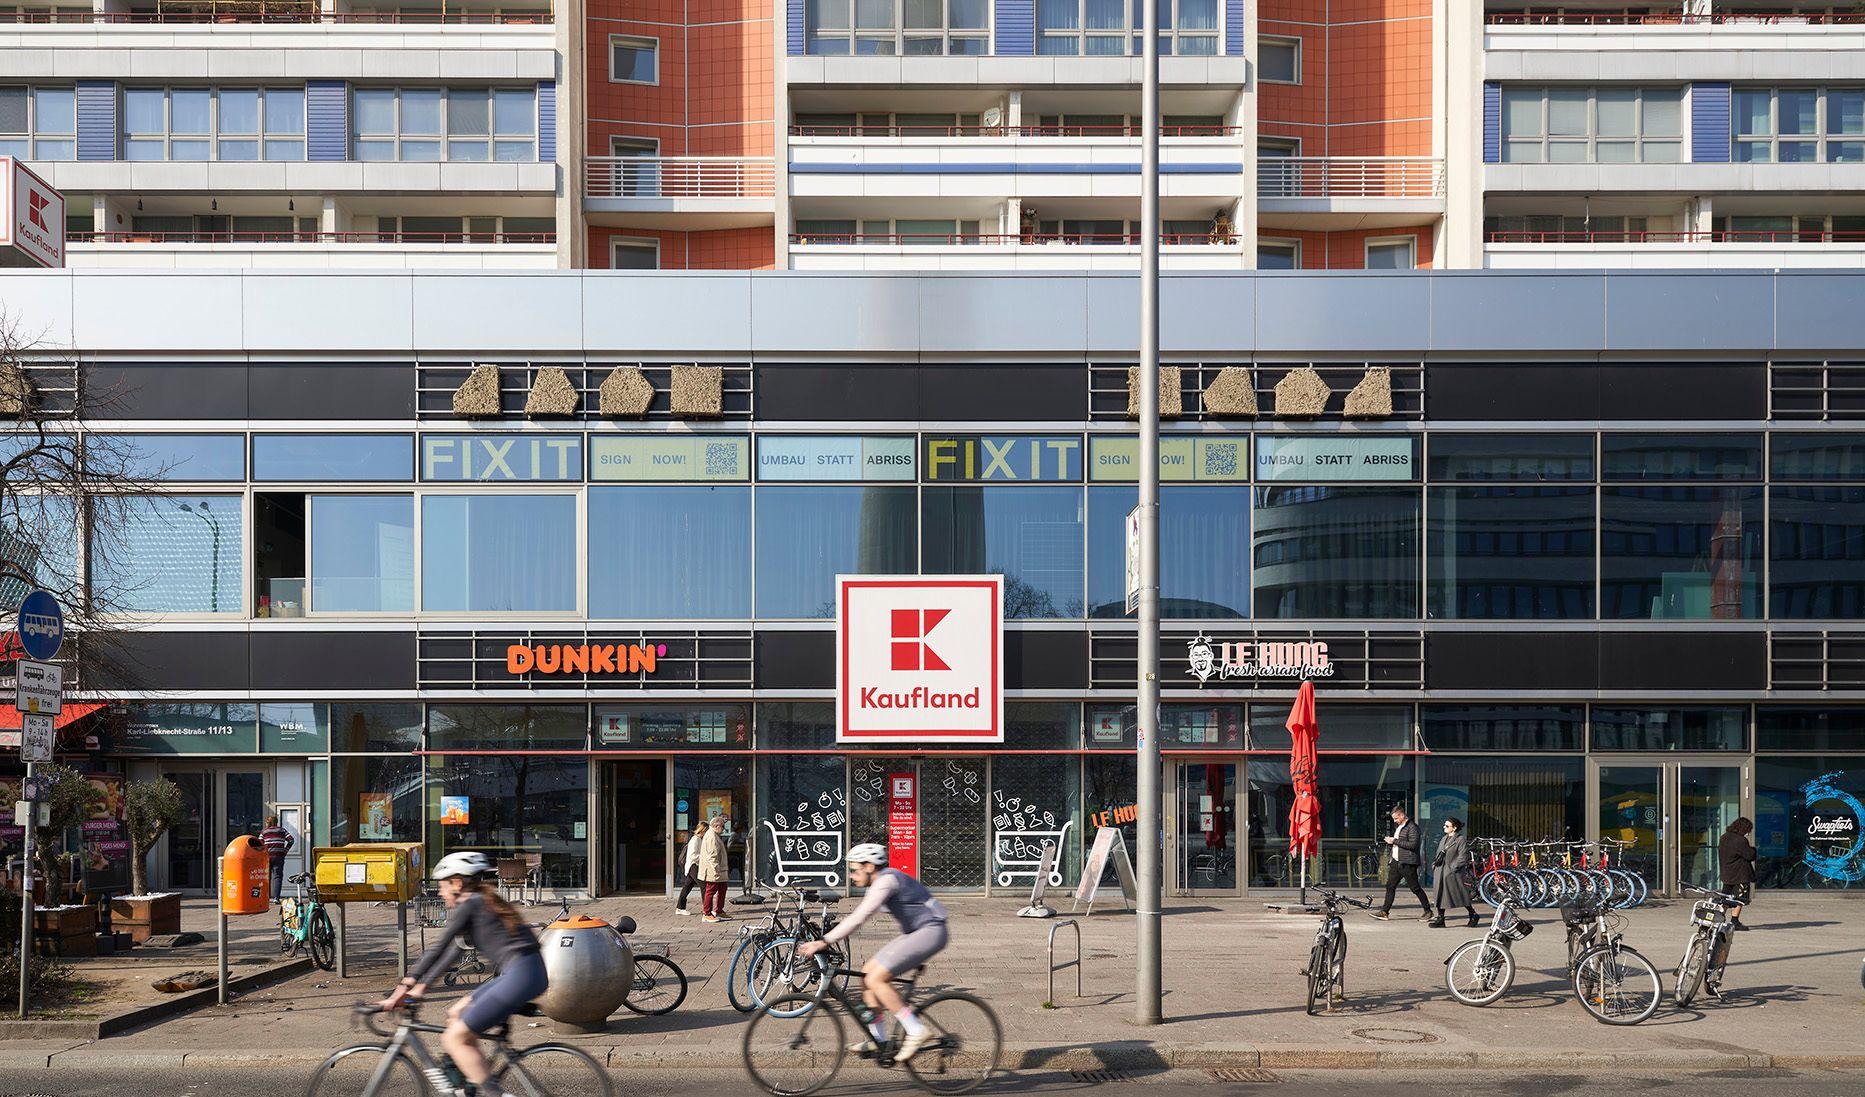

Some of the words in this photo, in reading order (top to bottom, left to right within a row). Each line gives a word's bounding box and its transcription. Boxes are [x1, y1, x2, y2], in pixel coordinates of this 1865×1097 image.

[19, 221, 59, 259] Kaufland
[425, 440, 516, 479] FIX
[530, 440, 579, 479] IT
[600, 453, 632, 465] SIGN
[652, 453, 687, 465] NOW!
[761, 454, 806, 465] UMBAU
[816, 454, 855, 465] STATT
[866, 454, 912, 465] ABRISS
[928, 440, 1017, 479] FIX
[1031, 440, 1079, 479] IT
[1099, 454, 1131, 465] SIGN
[1161, 454, 1185, 465] OW!
[1259, 454, 1304, 465] UMBAU
[1315, 454, 1353, 465] STATT
[1363, 454, 1408, 465] ABRISS
[507, 644, 667, 674] DUNKIN'
[1221, 642, 1251, 666] LE
[1219, 663, 1256, 680] fresh
[1257, 667, 1299, 677] asian
[1299, 662, 1334, 681] food
[19, 683, 60, 697] Krankenfahrzeuge
[860, 686, 980, 709] Kaufland
[41, 698, 53, 708] frei
[28, 718, 37, 727] Mo
[41, 718, 49, 727] Sa
[207, 726, 233, 735] 11/13
[1091, 811, 1110, 828] LE
[1807, 816, 1853, 834] Swapfiets
